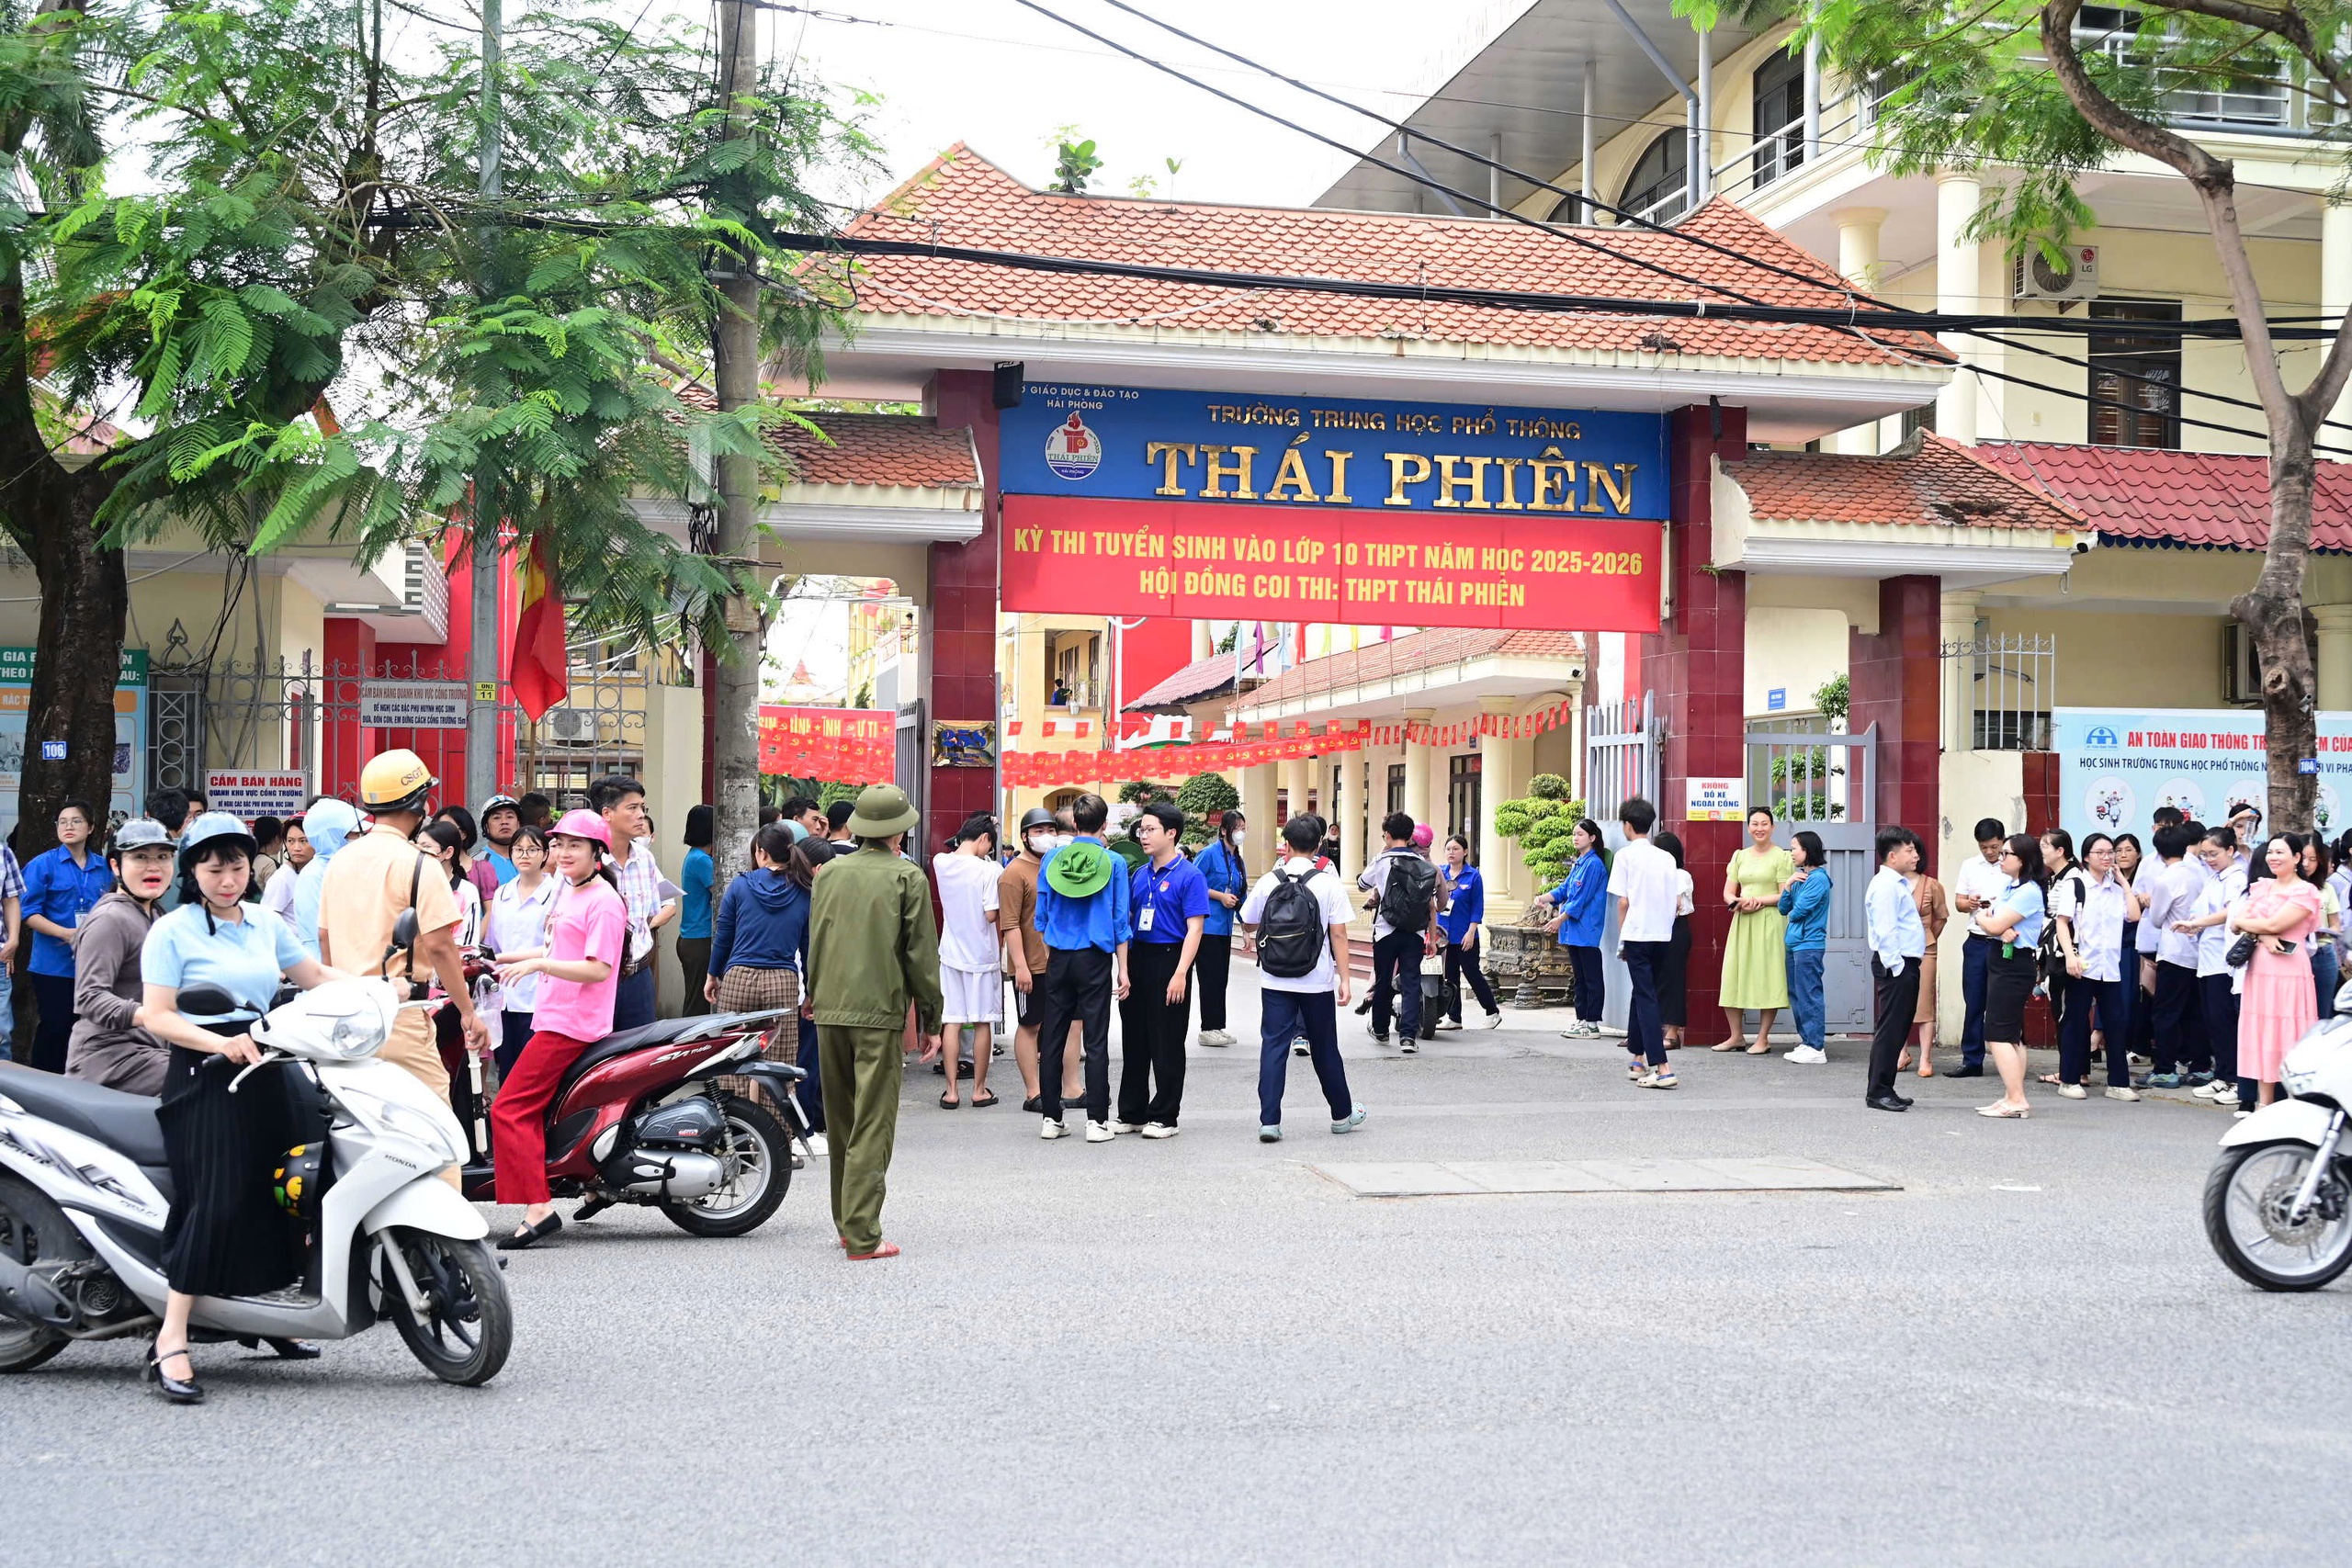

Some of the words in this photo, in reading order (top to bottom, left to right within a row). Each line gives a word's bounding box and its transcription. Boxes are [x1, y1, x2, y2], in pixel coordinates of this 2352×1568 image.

[2081, 265, 2093, 273] LG
[1030, 384, 1057, 395] GIÁO
[1060, 388, 1081, 398] DỤC
[1092, 387, 1115, 398] ĐÀO
[1119, 390, 1139, 400] TẠO
[1046, 397, 1064, 408] HẢI
[1068, 399, 1103, 410] PHÒNG
[1207, 401, 1301, 427] TRƯỜNG
[1310, 410, 1385, 431] TRUNG
[1396, 413, 1443, 436] HỌC
[1452, 408, 1497, 435] PHỔ
[1506, 416, 1581, 440] THÔNG
[1147, 431, 1354, 503] THÁI
[1384, 445, 1638, 514] PHIÊN
[1014, 525, 1044, 552] KỲ
[1050, 530, 1086, 555] THI
[1092, 525, 1165, 558] TUYỂN
[1172, 536, 1226, 559] SINH
[1233, 534, 1276, 563] VÀO
[1283, 536, 1325, 564] LỚP
[1332, 542, 1358, 566] 10
[1364, 543, 1419, 568] THPT
[1425, 541, 1475, 570] NĂM
[1481, 547, 1524, 576] HỌC
[1531, 549, 1643, 575] 2025-2026
[1139, 566, 1177, 599] HỘI
[1184, 565, 1246, 597] ĐỒNG
[1253, 574, 1290, 598] COI
[1297, 576, 1339, 601] THI:
[1345, 578, 1398, 603] THPT
[1405, 576, 1453, 604] THÁI
[1460, 579, 1524, 606] PHIÊN
[3, 651, 26, 662] GIA
[397, 688, 413, 700] QUANH
[414, 689, 424, 699] KHU
[391, 703, 401, 712] CÁC
[435, 705, 444, 715] HỌC
[414, 715, 426, 724] CÁCH
[2128, 731, 2143, 748] AN
[2146, 729, 2177, 748] TOÀN
[2180, 733, 2207, 749] GIAO
[2211, 731, 2249, 750] THÔNG
[45, 744, 64, 758] 106
[2079, 758, 2098, 771] HỌC
[2099, 758, 2120, 768] SINH
[2122, 756, 2158, 769] TRƯỜNG
[2160, 759, 2189, 770] TRUNG
[2191, 761, 2209, 773] HỌC
[2211, 758, 2228, 771] PHỔ
[2230, 760, 2259, 772] THÔNG
[2326, 763, 2335, 773] VI
[2301, 761, 2314, 772] 104
[210, 773, 237, 786] CẤM
[242, 775, 266, 786] BÁN
[269, 775, 302, 787] HÀNG
[401, 766, 423, 786] CSGT
[245, 790, 258, 798] VỰC
[260, 788, 277, 796] CỔNG
[385, 1154, 417, 1169] HONDA
